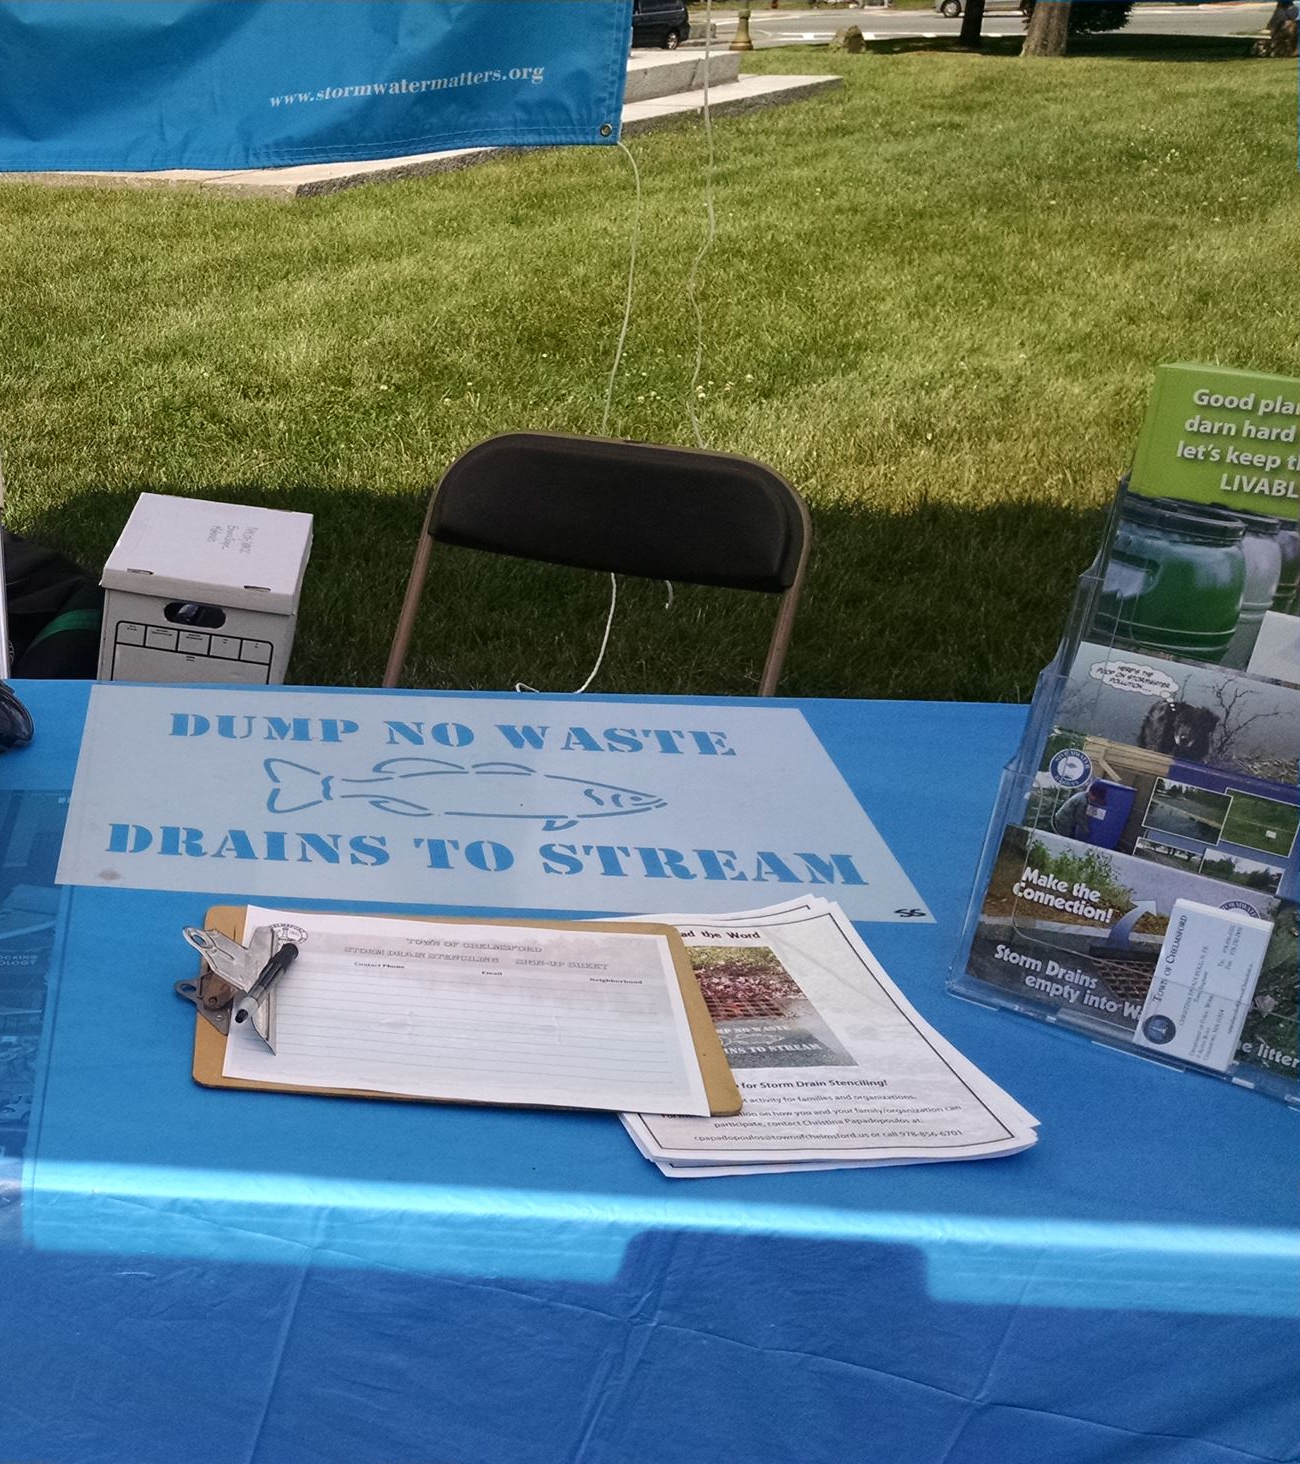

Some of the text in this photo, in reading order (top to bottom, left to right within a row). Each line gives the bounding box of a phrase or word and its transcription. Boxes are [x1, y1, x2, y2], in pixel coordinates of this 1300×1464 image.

[269, 65, 545, 108] www.stormwatermatters.org
[1193, 388, 1255, 410] Good
[1184, 415, 1296, 443] darn hard
[1177, 440, 1221, 462] let's
[1226, 446, 1281, 472] keep
[1220, 473, 1300, 498] LIVABL
[168, 712, 736, 756] DUMP NO WASTE
[105, 823, 869, 886] DRAINS TO STREAM
[1022, 866, 1101, 902] Make the
[1013, 882, 1113, 924] Connection!
[406, 938, 440, 946] TOWN
[463, 942, 542, 952] CHELMSFORD
[701, 930, 722, 938] the
[727, 931, 761, 939] Word
[344, 947, 385, 956] STORM
[387, 950, 427, 959] DRAIN
[567, 961, 609, 970] SHEET
[994, 944, 1098, 989] Storm Drains
[1025, 975, 1081, 1004] empty
[1084, 990, 1119, 1013] into
[768, 1043, 822, 1052] STREAM
[795, 1080, 827, 1088] Drain
[829, 1079, 888, 1088] Stenciling!
[714, 1121, 766, 1129] participate,
[845, 1117, 910, 1125] Papadopoulos
[855, 1107, 943, 1115] family/organization
